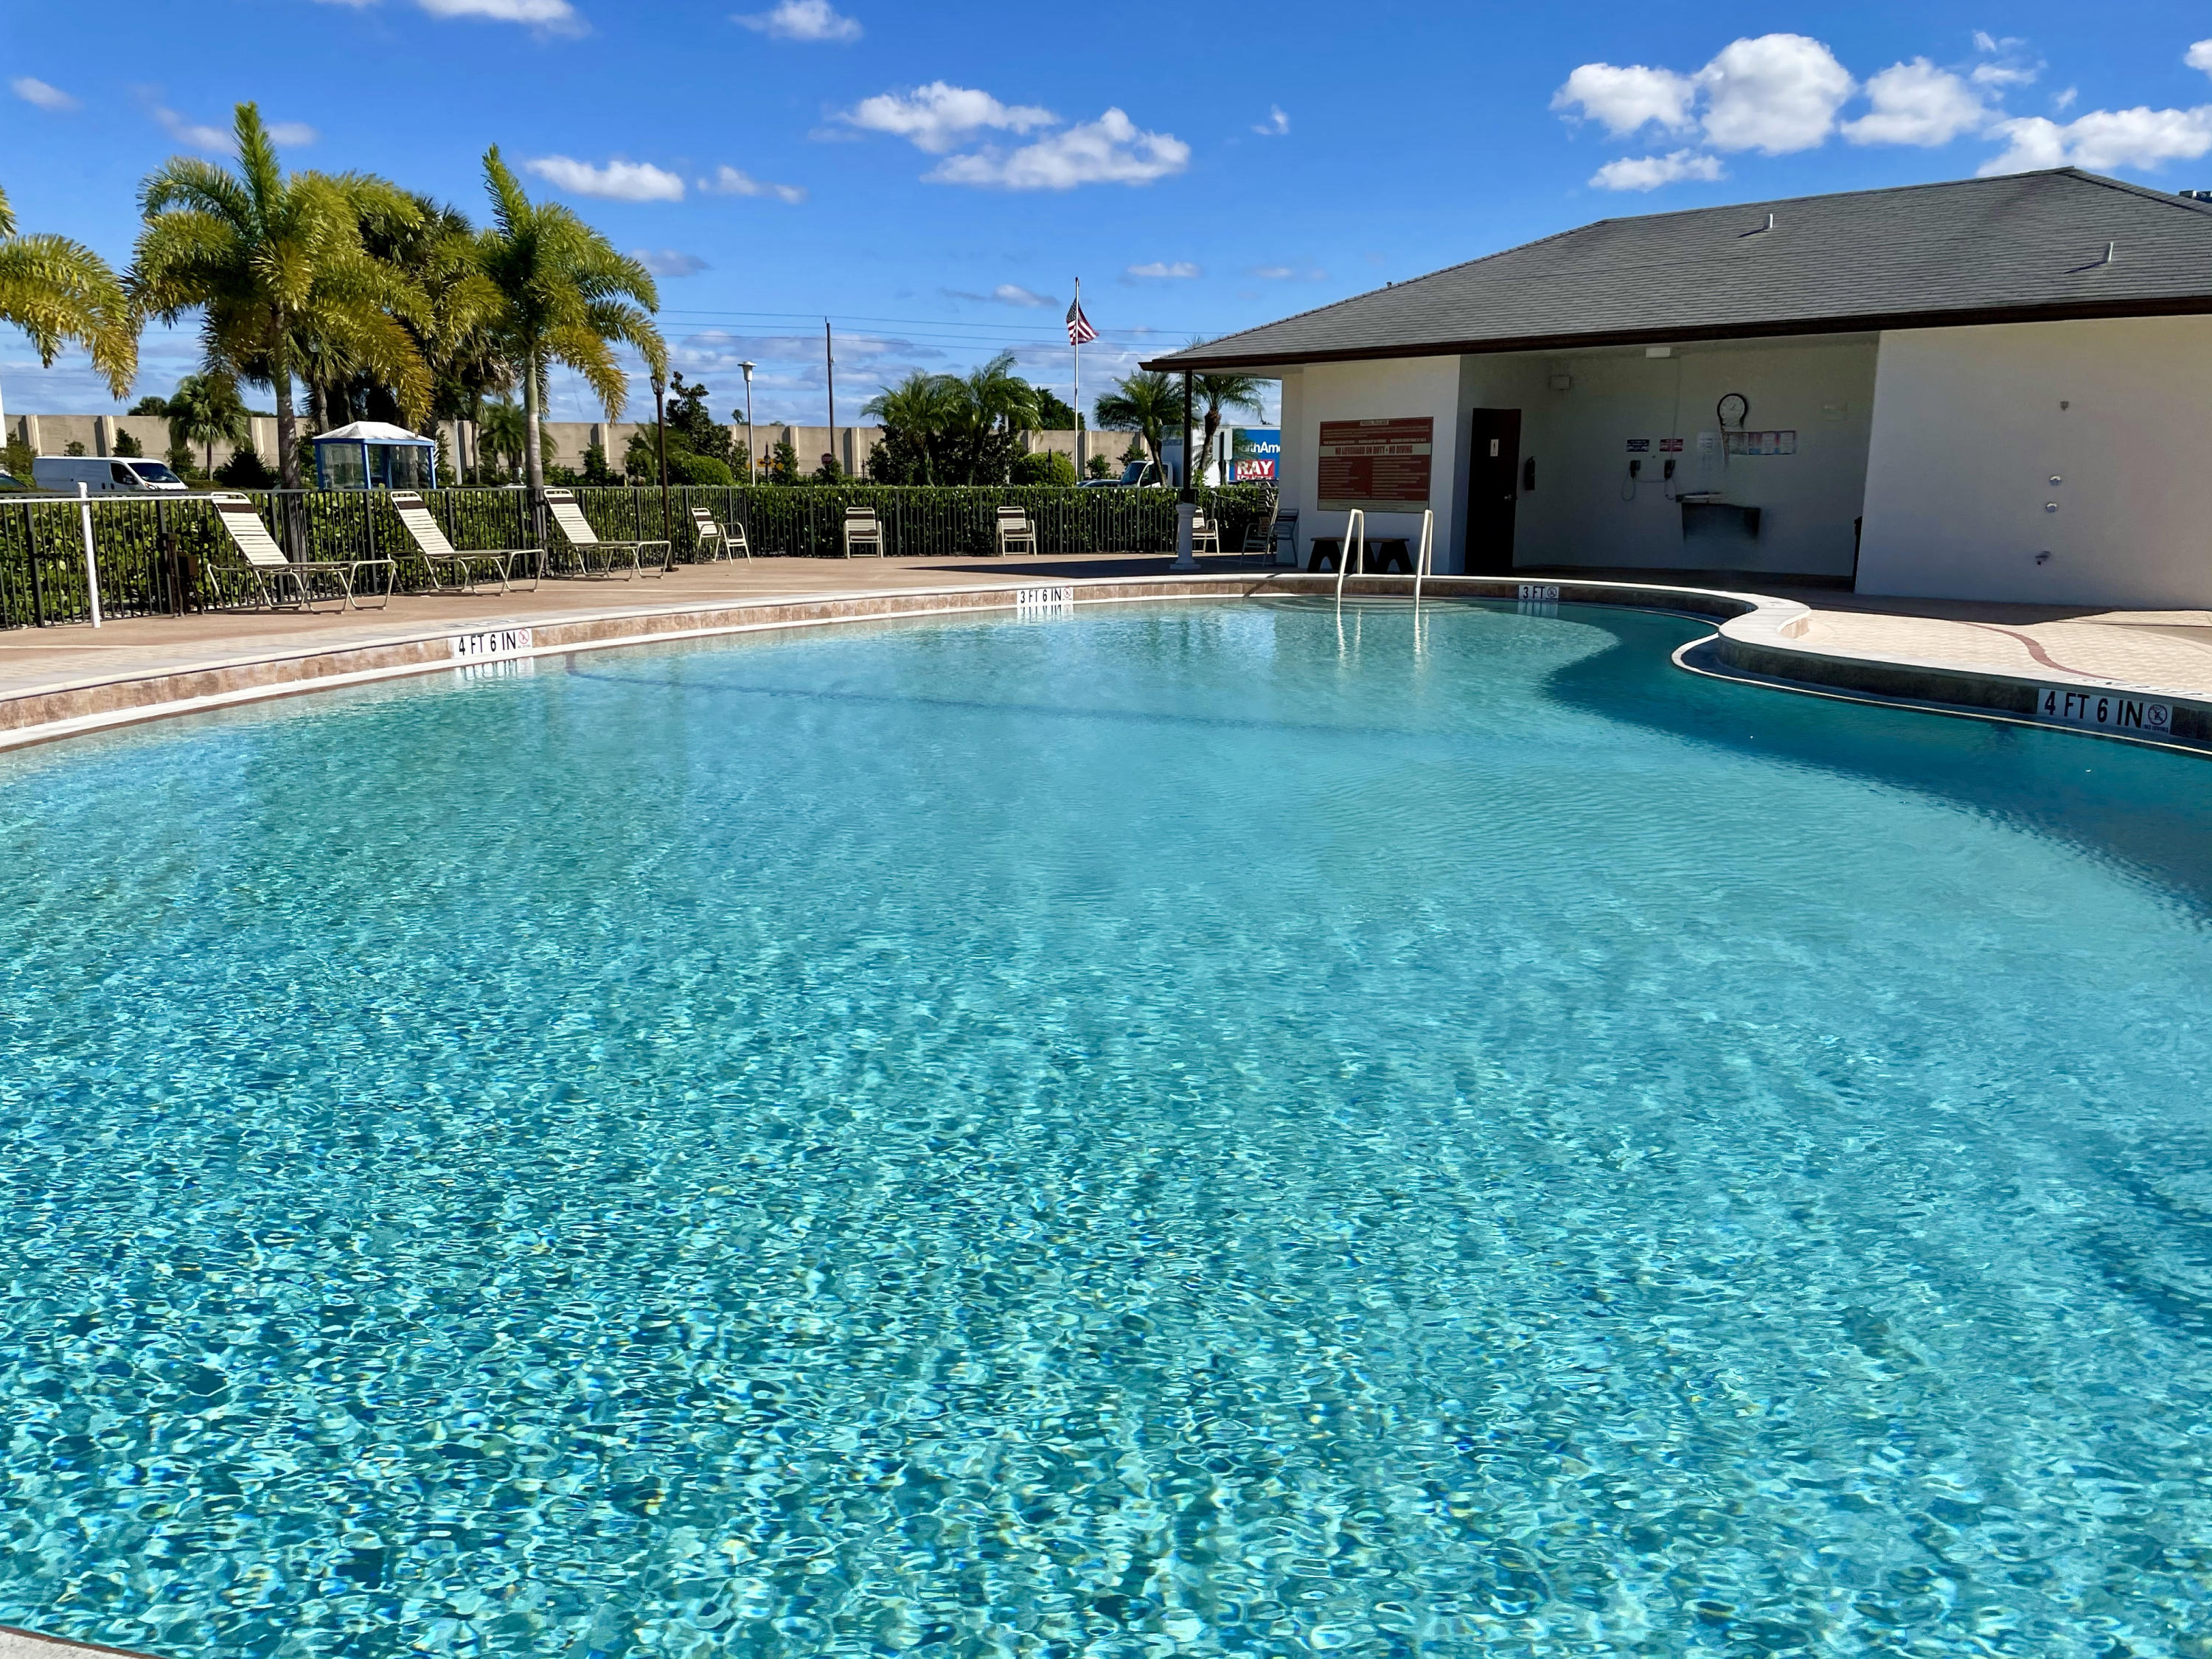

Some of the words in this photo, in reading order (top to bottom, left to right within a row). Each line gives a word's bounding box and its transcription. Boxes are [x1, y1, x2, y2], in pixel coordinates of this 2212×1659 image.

[1373, 445, 1385, 454] DUTY
[1389, 445, 1395, 454] NO
[1237, 461, 1273, 475] RAY
[1020, 591, 1026, 603] 3
[1029, 590, 1039, 602] FT
[1043, 588, 1047, 602] 6
[1051, 588, 1061, 602] IN
[1523, 586, 1528, 599] 3
[1533, 585, 1545, 599] FT
[459, 636, 465, 655] 4
[470, 633, 484, 654] FT
[490, 633, 496, 652] 6
[501, 631, 516, 650] IN
[2045, 691, 2056, 715] 4
[2065, 692, 2090, 719] FT
[2097, 698, 2109, 723] 6
[2116, 699, 2143, 728] IN
